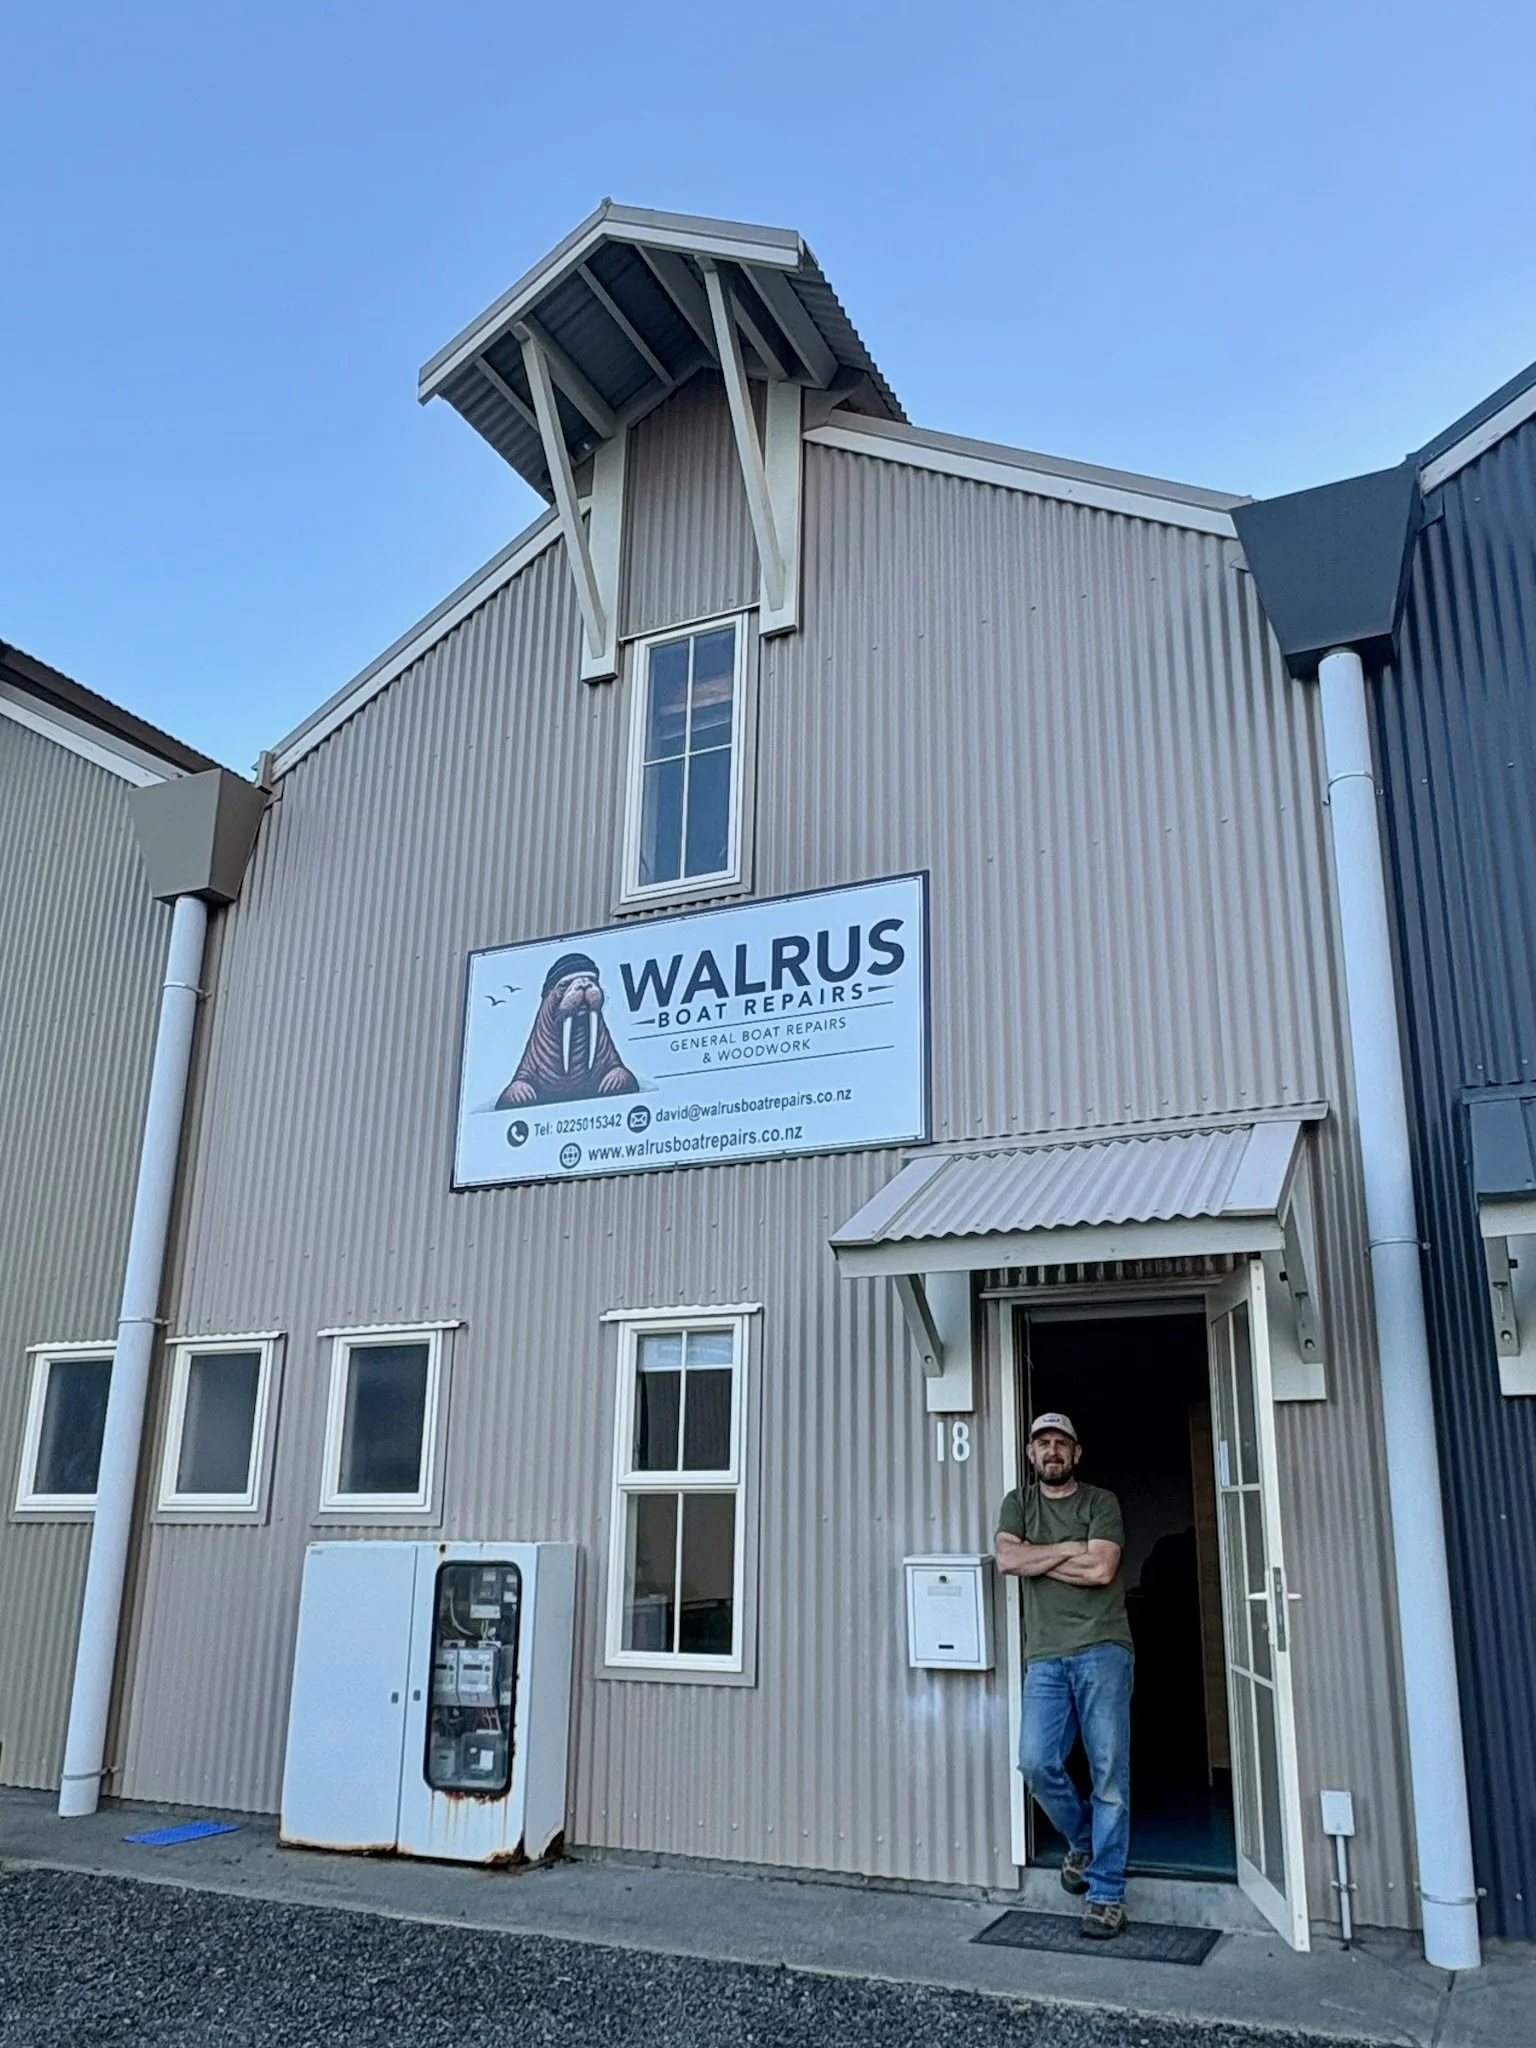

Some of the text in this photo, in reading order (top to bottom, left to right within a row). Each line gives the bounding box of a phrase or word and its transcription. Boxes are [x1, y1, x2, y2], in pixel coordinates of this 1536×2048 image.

[619, 918, 905, 1012] WALRUS
[657, 982, 864, 1028] BOAT REPAIRS
[669, 1016, 847, 1052] GENERAL BOAT REPAIRS
[702, 1038, 812, 1064] & WOODWORK
[655, 1088, 852, 1122] david@walrusboatrepairs.co.nz
[534, 1113, 623, 1137] Tel: 0225015342
[588, 1126, 803, 1161] www.walrusboatrepairs.co.nz
[936, 1421, 970, 1462] 18
